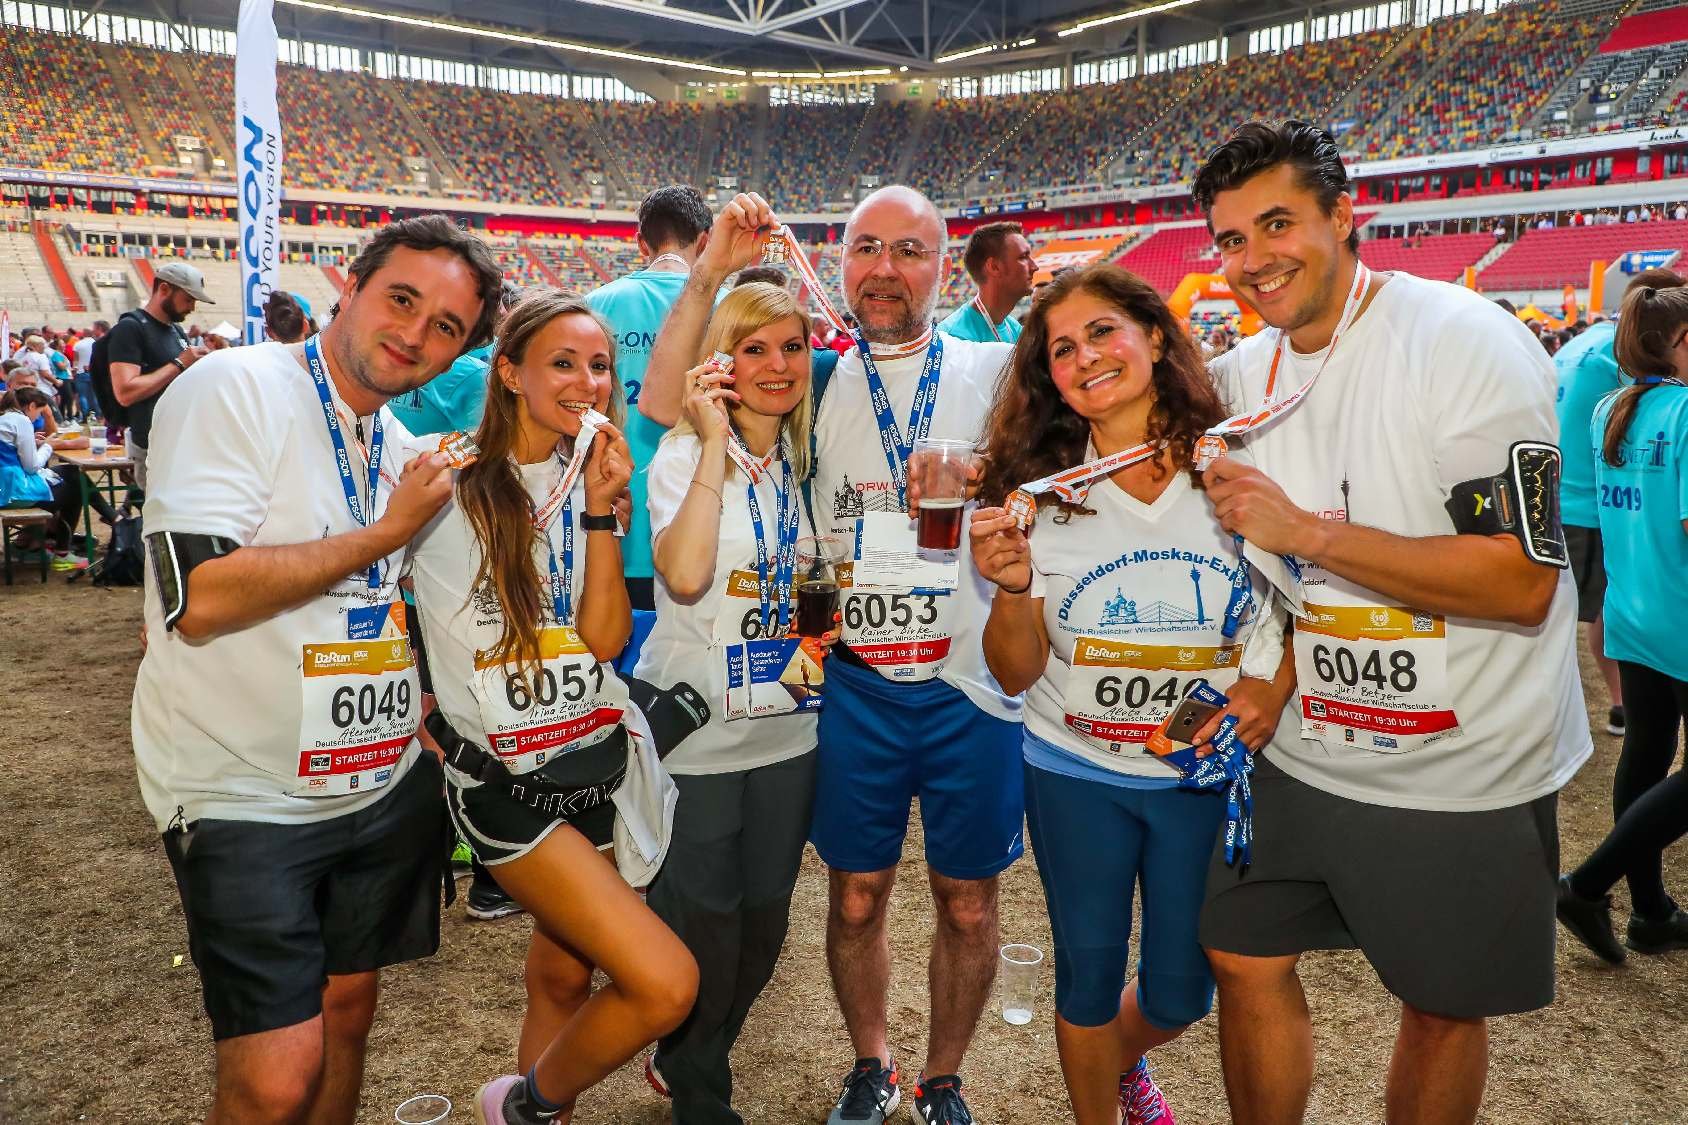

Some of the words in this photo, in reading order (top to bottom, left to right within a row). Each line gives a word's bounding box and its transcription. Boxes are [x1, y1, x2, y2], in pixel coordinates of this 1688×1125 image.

[265, 132, 277, 206] VISION
[260, 215, 275, 273] YOUR
[310, 358, 325, 385] EPSON
[863, 353, 876, 375] EPSON
[923, 357, 933, 378] EPSON
[933, 350, 942, 371] EPSON
[876, 387, 889, 410] EPSON
[914, 388, 925, 412] EPSON
[927, 382, 938, 405] EPSON
[324, 401, 337, 430] EPSON
[889, 423, 901, 446] EPSON
[906, 425, 916, 449] EPSON
[919, 417, 930, 441] EPSON
[337, 448, 351, 478] EPSON
[370, 444, 381, 469] EPSON
[855, 483, 889, 492] DRW
[1601, 484, 1642, 511] 2019
[565, 526, 573, 552] EPSON
[758, 538, 767, 563] EPSON
[787, 543, 795, 568] EPSON
[551, 571, 562, 598] EPSON
[565, 568, 573, 594] EPSON
[760, 579, 768, 604] EPSON
[845, 595, 938, 629] 6053
[1231, 591, 1250, 618] EPSON
[861, 626, 895, 637] Rainer
[899, 625, 934, 635] Birke
[1134, 624, 1199, 634] Wirtschaftsclub
[896, 649, 918, 657] 19:30
[920, 648, 934, 656] Uhr
[1312, 643, 1418, 693] 6048
[505, 662, 605, 712] 6051
[1335, 683, 1356, 695] Juri
[1361, 686, 1404, 701] Betzer
[331, 678, 411, 729] 6049
[1371, 699, 1430, 711] Wirtschaftsclub
[1329, 706, 1372, 723] STARTZEIT
[1374, 715, 1397, 727] 19:30
[1399, 718, 1419, 728] Uhr
[520, 728, 567, 746] STARTZEIT
[1096, 726, 1150, 737] STARTZEIT
[1216, 727, 1237, 752] EPSON
[335, 751, 378, 766] STARTZEIT
[1198, 771, 1226, 787] EPSON
[1226, 820, 1237, 847] EPSON
